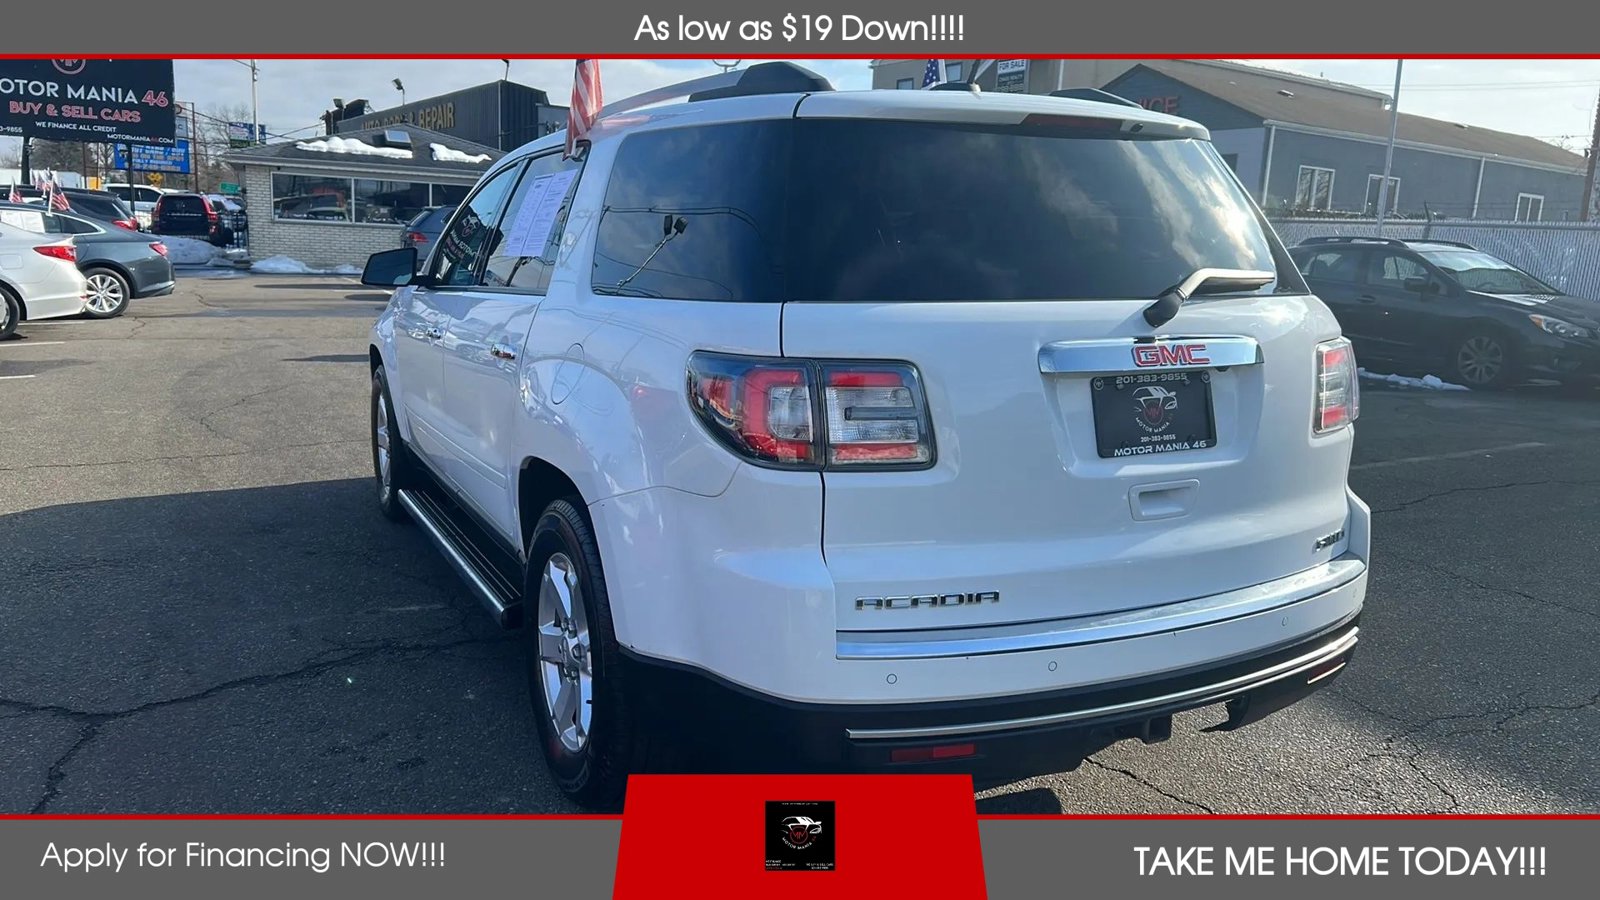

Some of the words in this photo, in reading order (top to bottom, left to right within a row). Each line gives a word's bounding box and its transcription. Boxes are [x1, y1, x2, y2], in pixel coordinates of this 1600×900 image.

[67, 84, 138, 104] MANIA
[142, 90, 169, 107] 46
[9, 101, 42, 115] BUY
[46, 104, 59, 116] &
[61, 105, 98, 119] SELL
[100, 108, 141, 123] CARS
[419, 102, 455, 130] REPAIR
[48, 122, 77, 130] FINANCE
[1131, 344, 1210, 367] GMC
[1115, 372, 1188, 385] 201-383-9855
[1114, 444, 1153, 457] MOTOR
[1155, 442, 1189, 453] MANIA
[1192, 440, 1207, 449] 46
[855, 589, 1000, 611] ACADIA
